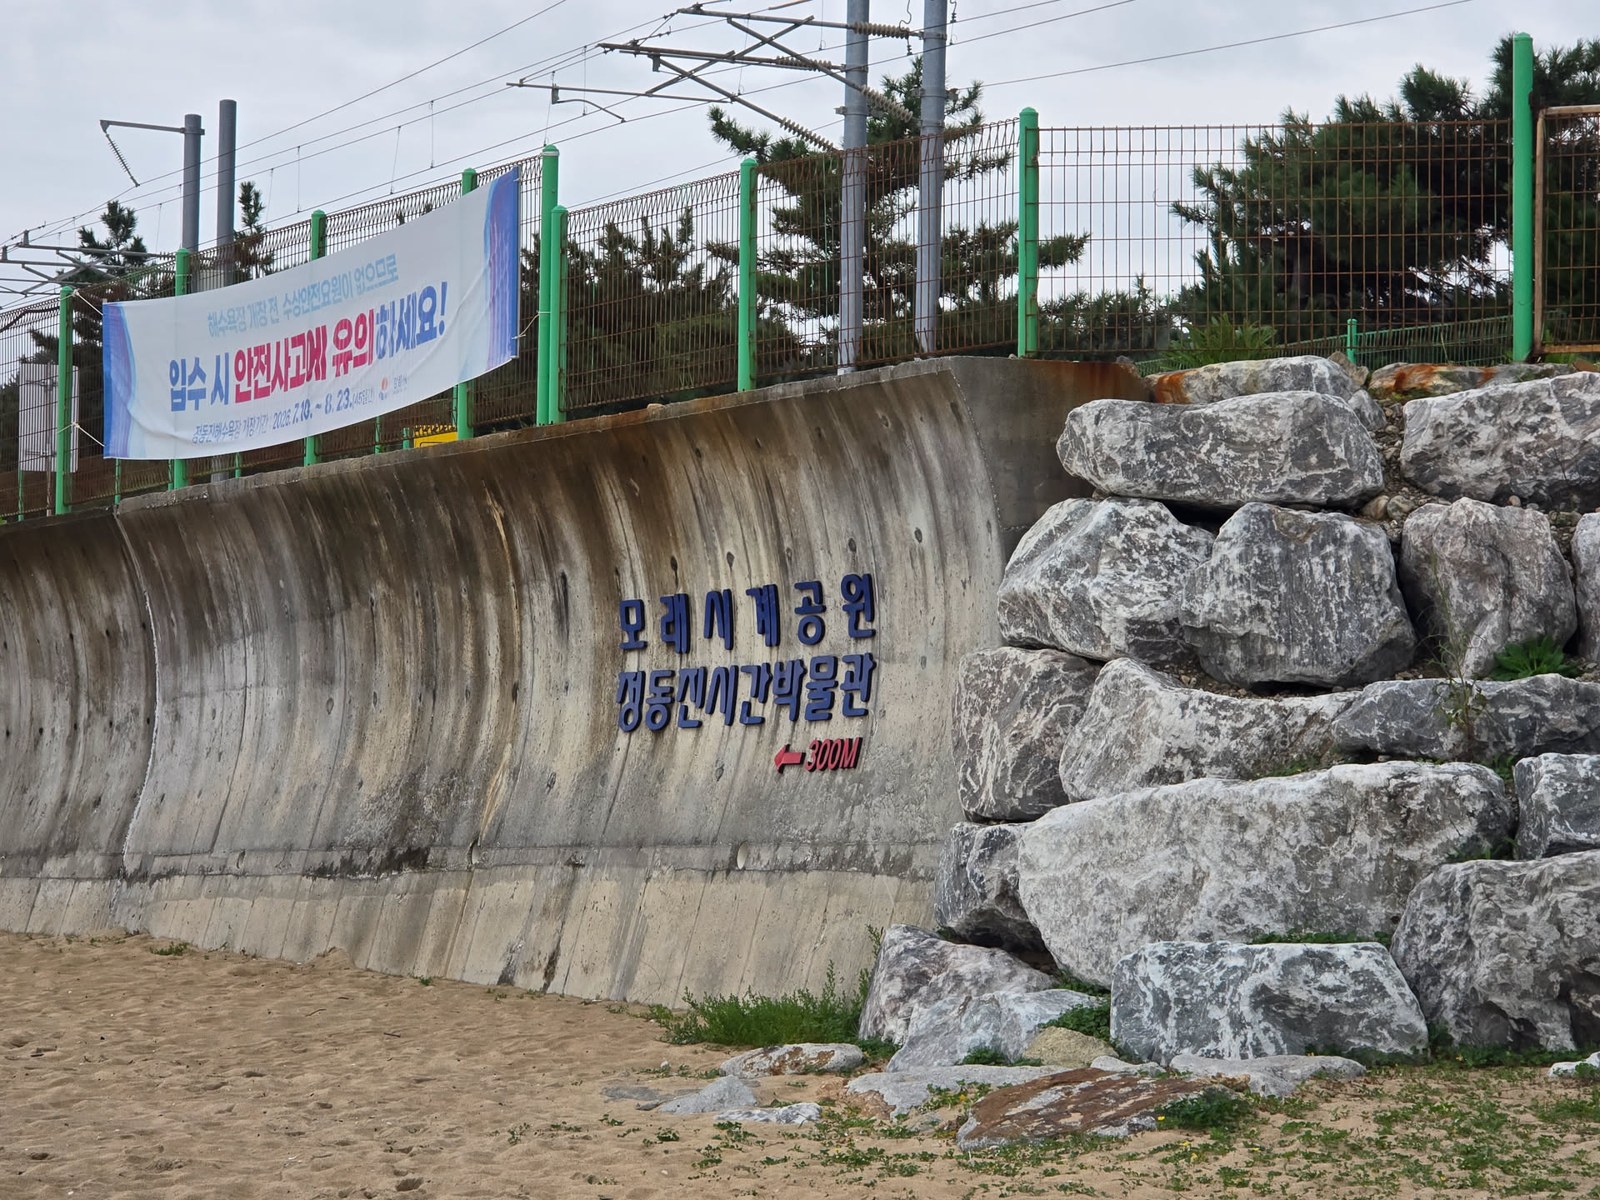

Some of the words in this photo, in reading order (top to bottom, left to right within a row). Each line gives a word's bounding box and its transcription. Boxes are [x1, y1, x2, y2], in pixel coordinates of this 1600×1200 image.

[208, 305, 246, 337] 해수욕장
[247, 300, 267, 329] 개장
[269, 295, 280, 324] 전
[284, 271, 353, 320] 수상안전요원이
[354, 253, 398, 295] 없으므로
[169, 357, 207, 412] 입수
[211, 352, 229, 406] 시
[234, 325, 328, 404] 안전사고에
[332, 281, 448, 378] 유의하세요!
[616, 652, 876, 732] 정동진시간박물관
[805, 737, 862, 772] 300M
